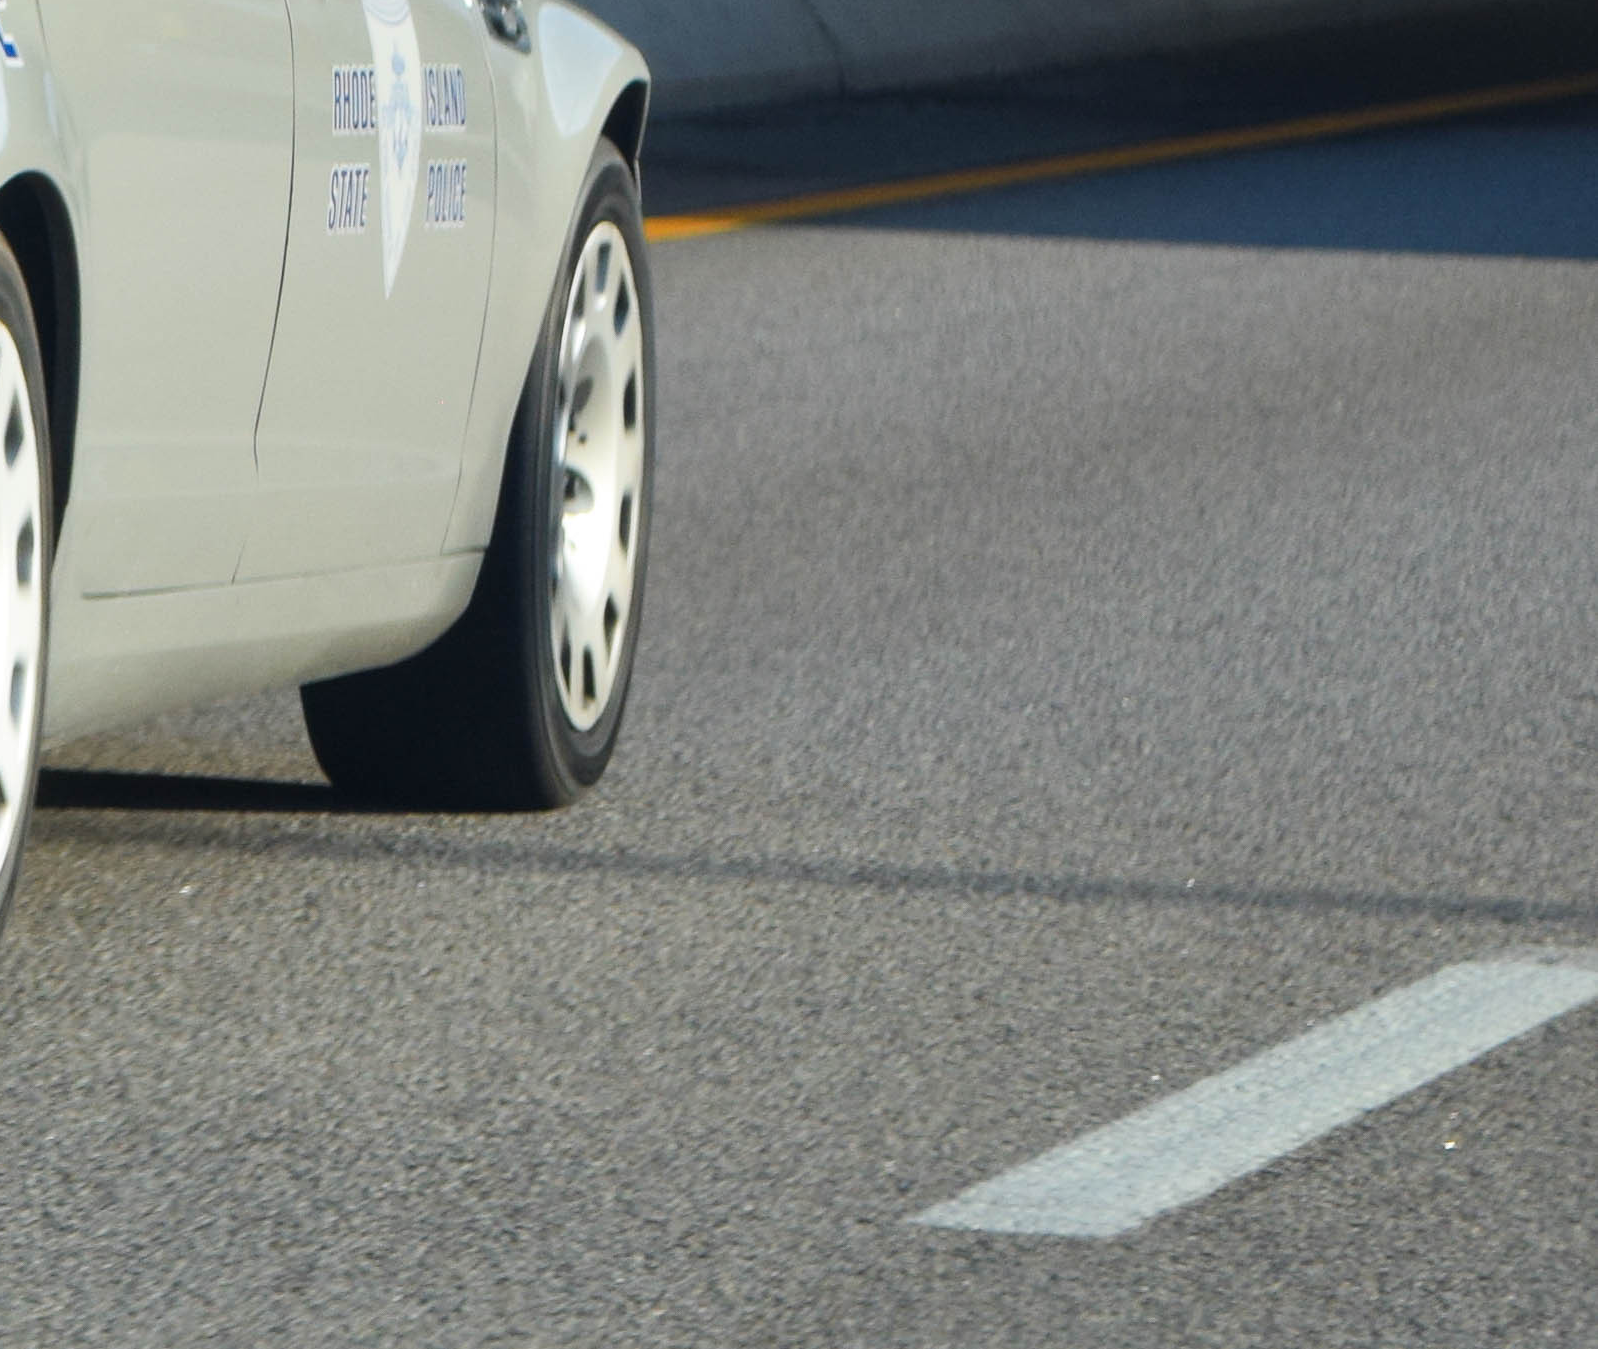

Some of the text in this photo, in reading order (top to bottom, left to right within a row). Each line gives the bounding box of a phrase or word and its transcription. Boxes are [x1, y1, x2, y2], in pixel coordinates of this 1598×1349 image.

[332, 63, 467, 135] RHODE ISLAND
[327, 158, 467, 235] STATE POLICE
